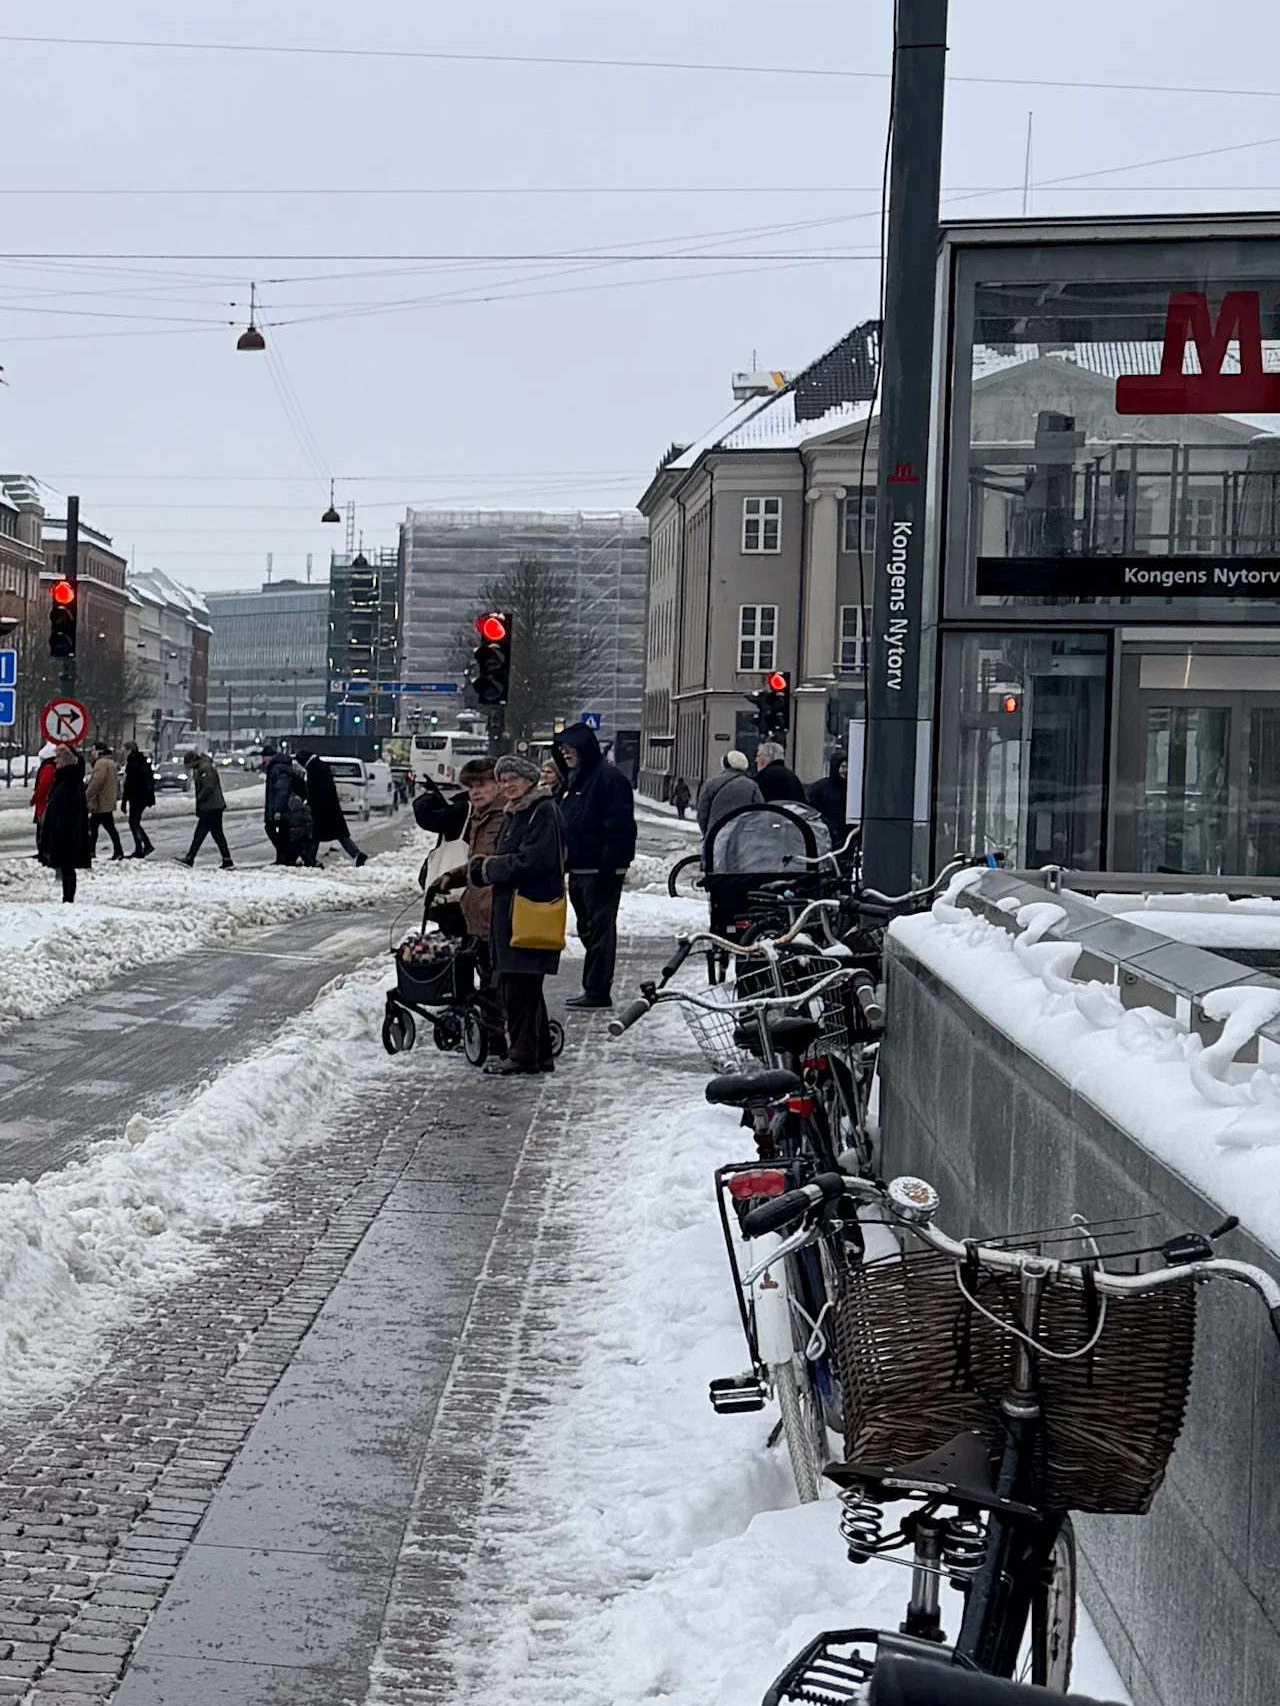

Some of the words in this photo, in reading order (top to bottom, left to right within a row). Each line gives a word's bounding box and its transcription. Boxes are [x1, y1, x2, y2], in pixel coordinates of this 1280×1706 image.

[887, 521, 912, 611] Kongens
[1124, 567, 1207, 587] Kongens
[1213, 567, 1280, 587] Nytorv
[884, 618, 908, 691] Nytorv
